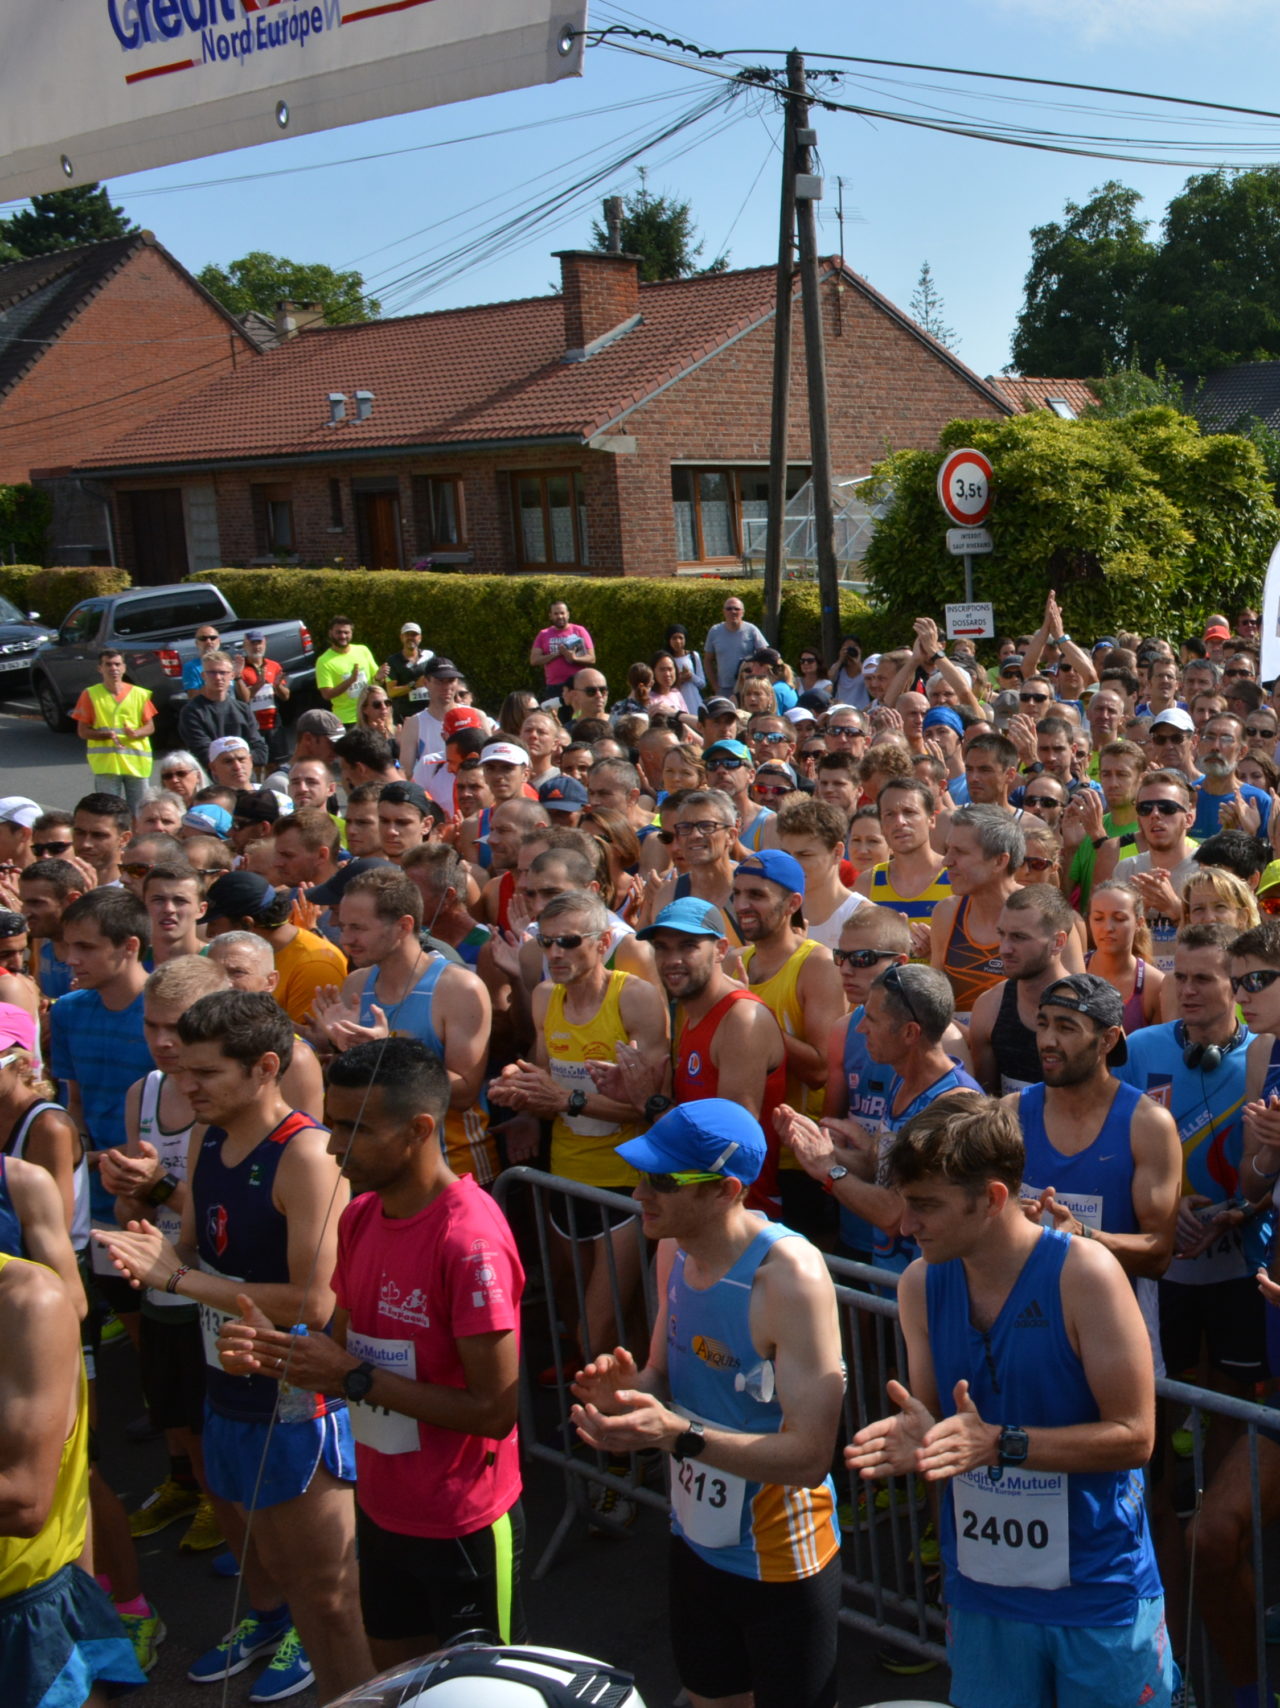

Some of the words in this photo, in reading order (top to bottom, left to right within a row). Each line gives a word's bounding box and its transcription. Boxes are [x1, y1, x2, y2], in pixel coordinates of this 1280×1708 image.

[200, 19, 250, 63] Nord
[256, 5, 324, 47] Europe
[946, 604, 990, 613] INSCRIPTIONS
[952, 618, 987, 627] DOSSARDS
[1014, 1319, 1048, 1328] adidas
[364, 1345, 408, 1361] Mutuel
[678, 1460, 728, 1509] 2213
[960, 1471, 990, 1487] rédit
[1007, 1475, 1062, 1490] Mutuel
[962, 1509, 1049, 1550] 2400
